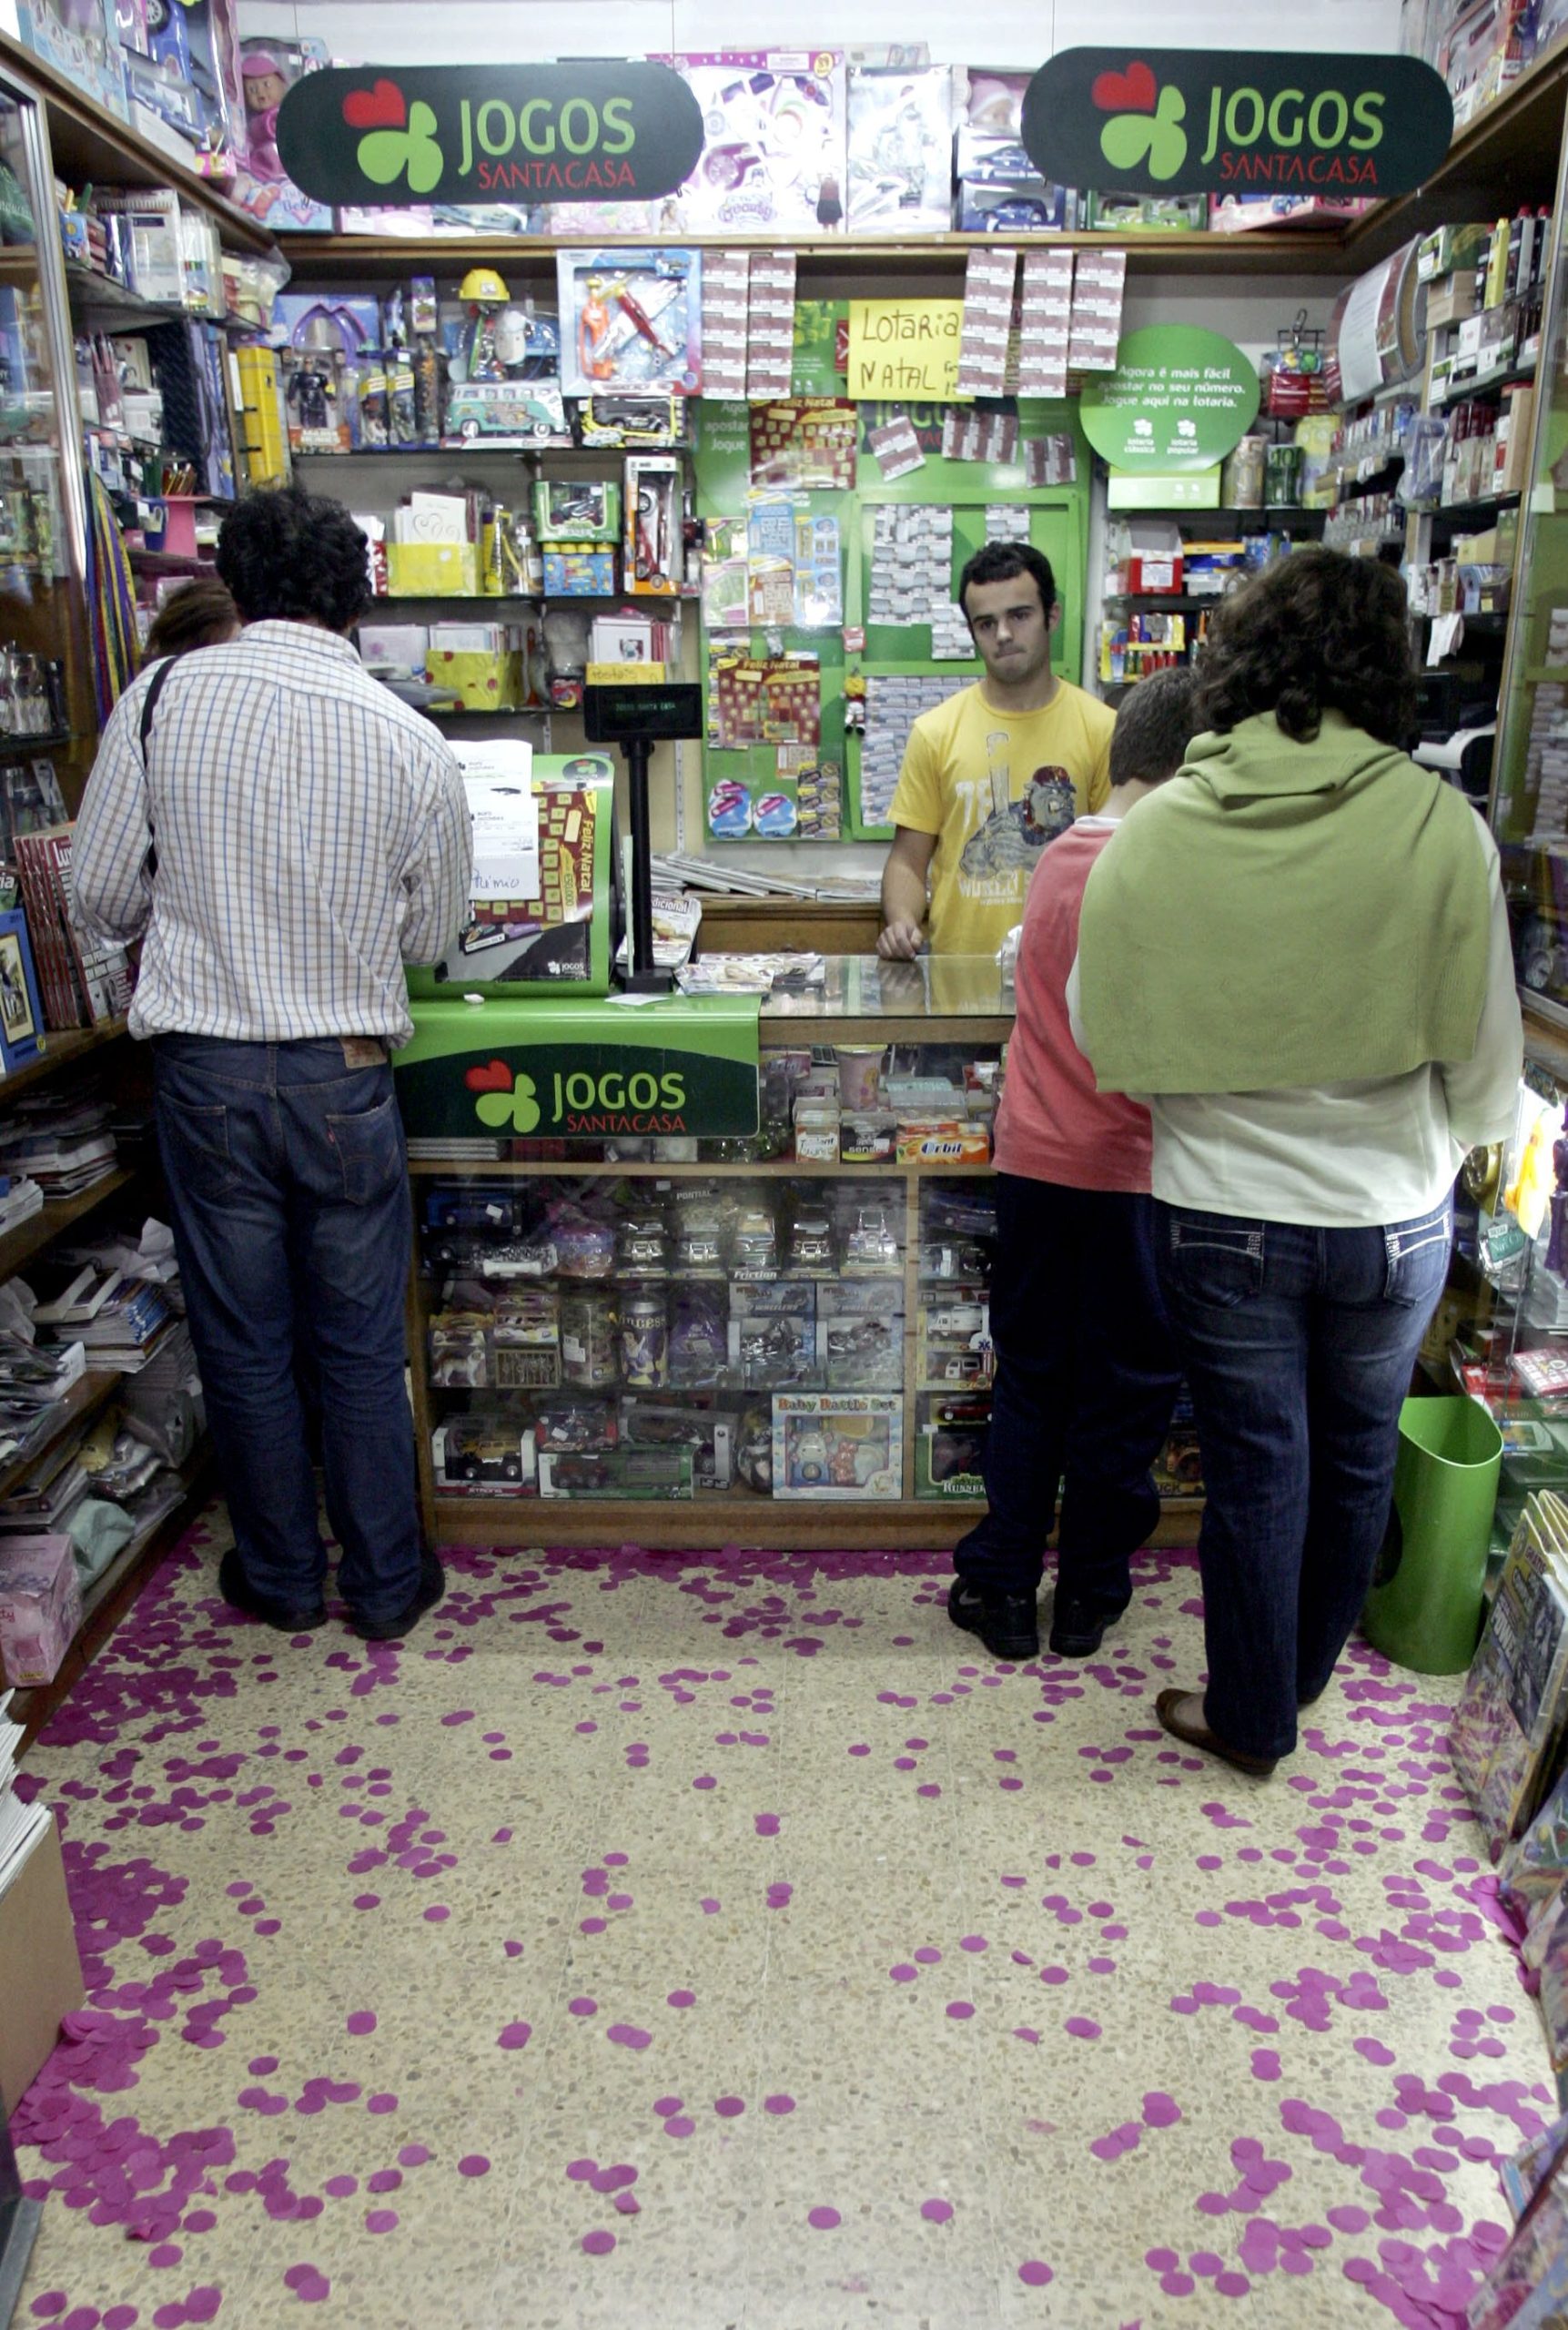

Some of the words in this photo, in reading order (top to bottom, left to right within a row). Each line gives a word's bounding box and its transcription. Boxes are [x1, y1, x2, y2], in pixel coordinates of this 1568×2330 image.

[1201, 86, 1385, 165] JOGOS
[458, 98, 635, 176] JOGOS
[478, 160, 636, 190] SANTACASA
[1219, 153, 1378, 186] SANTACASA
[1117, 366, 1155, 379] Agora
[1158, 367, 1167, 378] é
[1170, 367, 1199, 380] mais
[1203, 367, 1231, 380] fácil
[1098, 381, 1144, 393] apostar
[1148, 382, 1165, 392] no
[1168, 382, 1190, 392] seu
[1102, 395, 1138, 408] Jogue
[1141, 395, 1170, 409] aqui
[1174, 397, 1189, 407] na
[711, 439, 747, 455] Jogue
[768, 659, 801, 671] Natal
[581, 820, 594, 850] Feliz
[580, 852, 593, 894] Natal
[551, 1072, 686, 1122] JOGOS
[568, 1114, 687, 1133] SANTACASA
[921, 1140, 962, 1156] Orbit
[778, 1398, 816, 1413] Baby
